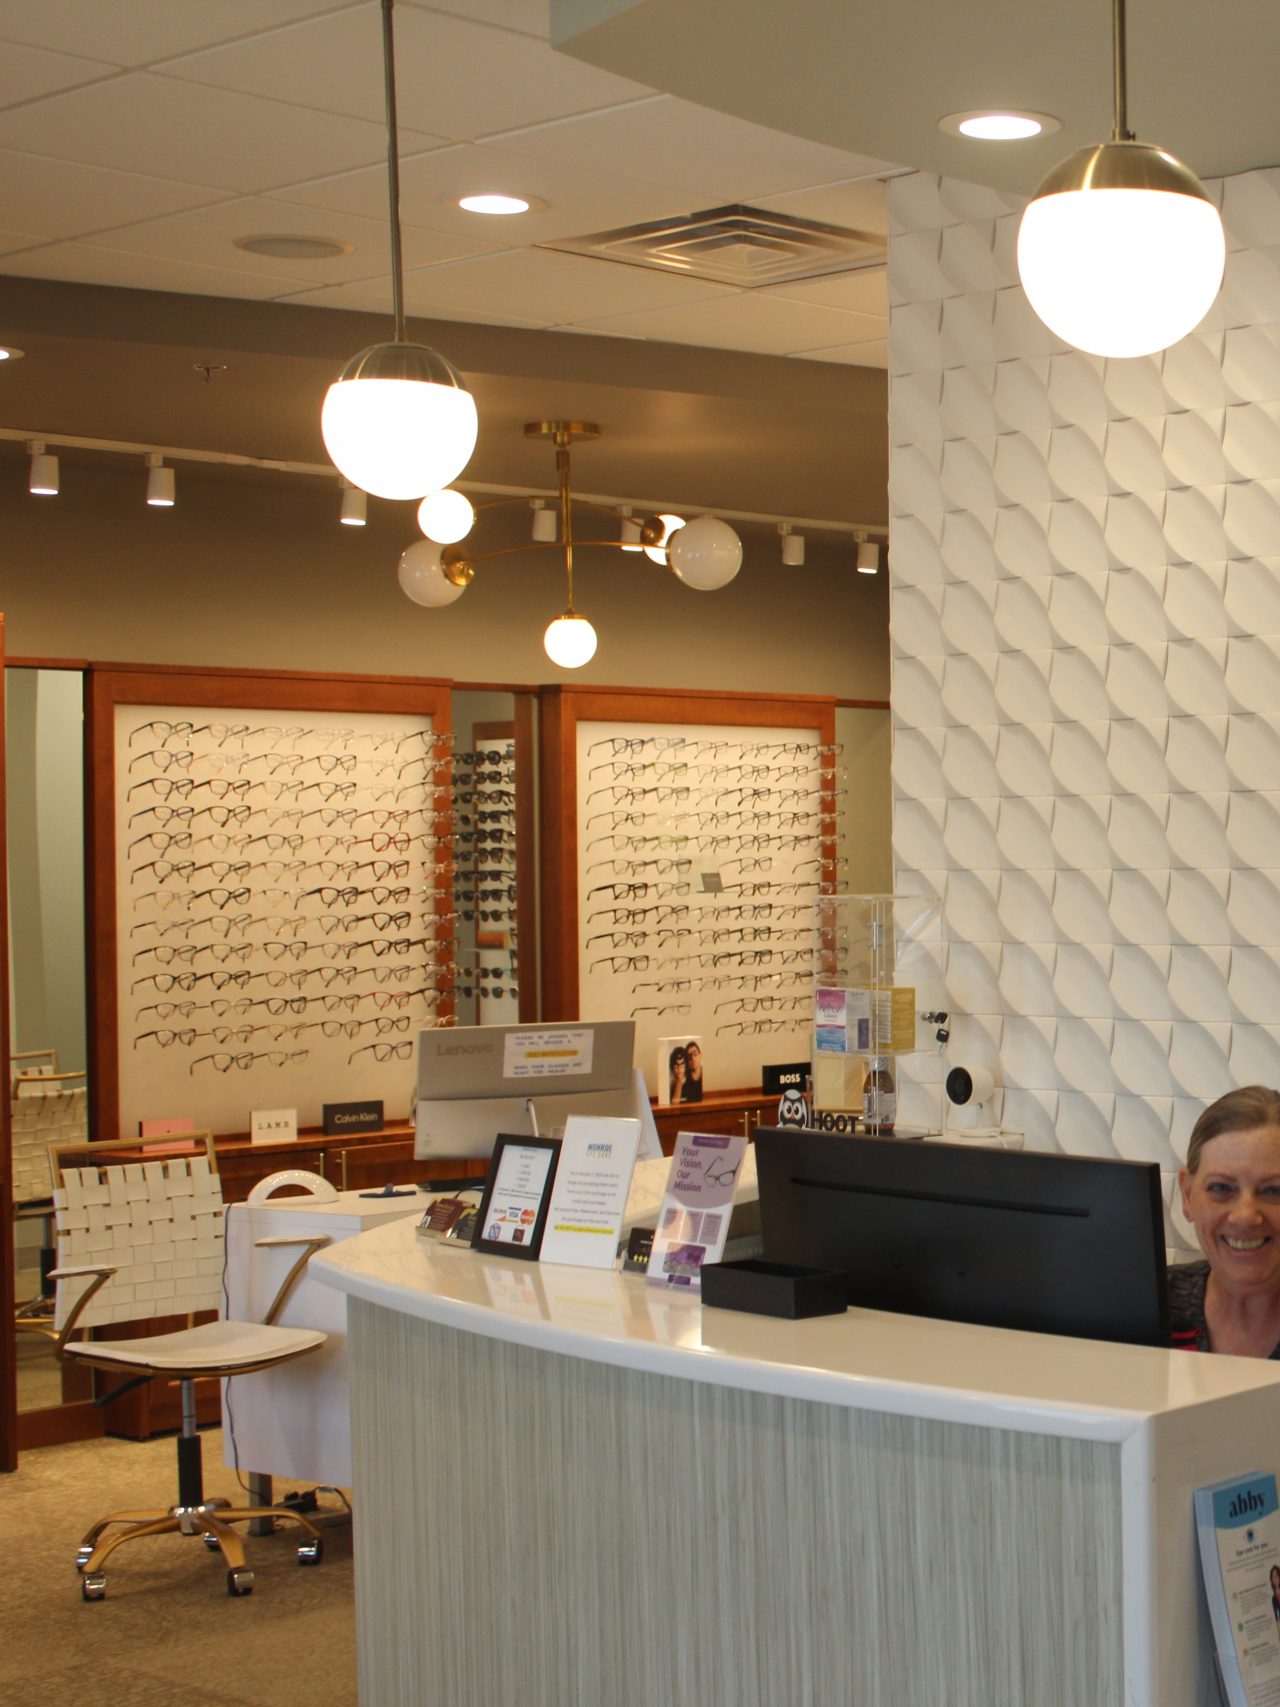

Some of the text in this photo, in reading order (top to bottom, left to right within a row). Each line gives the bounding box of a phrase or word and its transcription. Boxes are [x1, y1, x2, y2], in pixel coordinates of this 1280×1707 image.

[436, 1043, 494, 1056] Lenovo
[779, 1073, 801, 1084] BOSS
[334, 1112, 378, 1125] Calvin Klein
[811, 1109, 859, 1134] HOOT
[682, 1146, 700, 1157] Your
[676, 1169, 691, 1179] Our
[673, 1181, 702, 1193] Mission
[1229, 1489, 1266, 1518] abby
